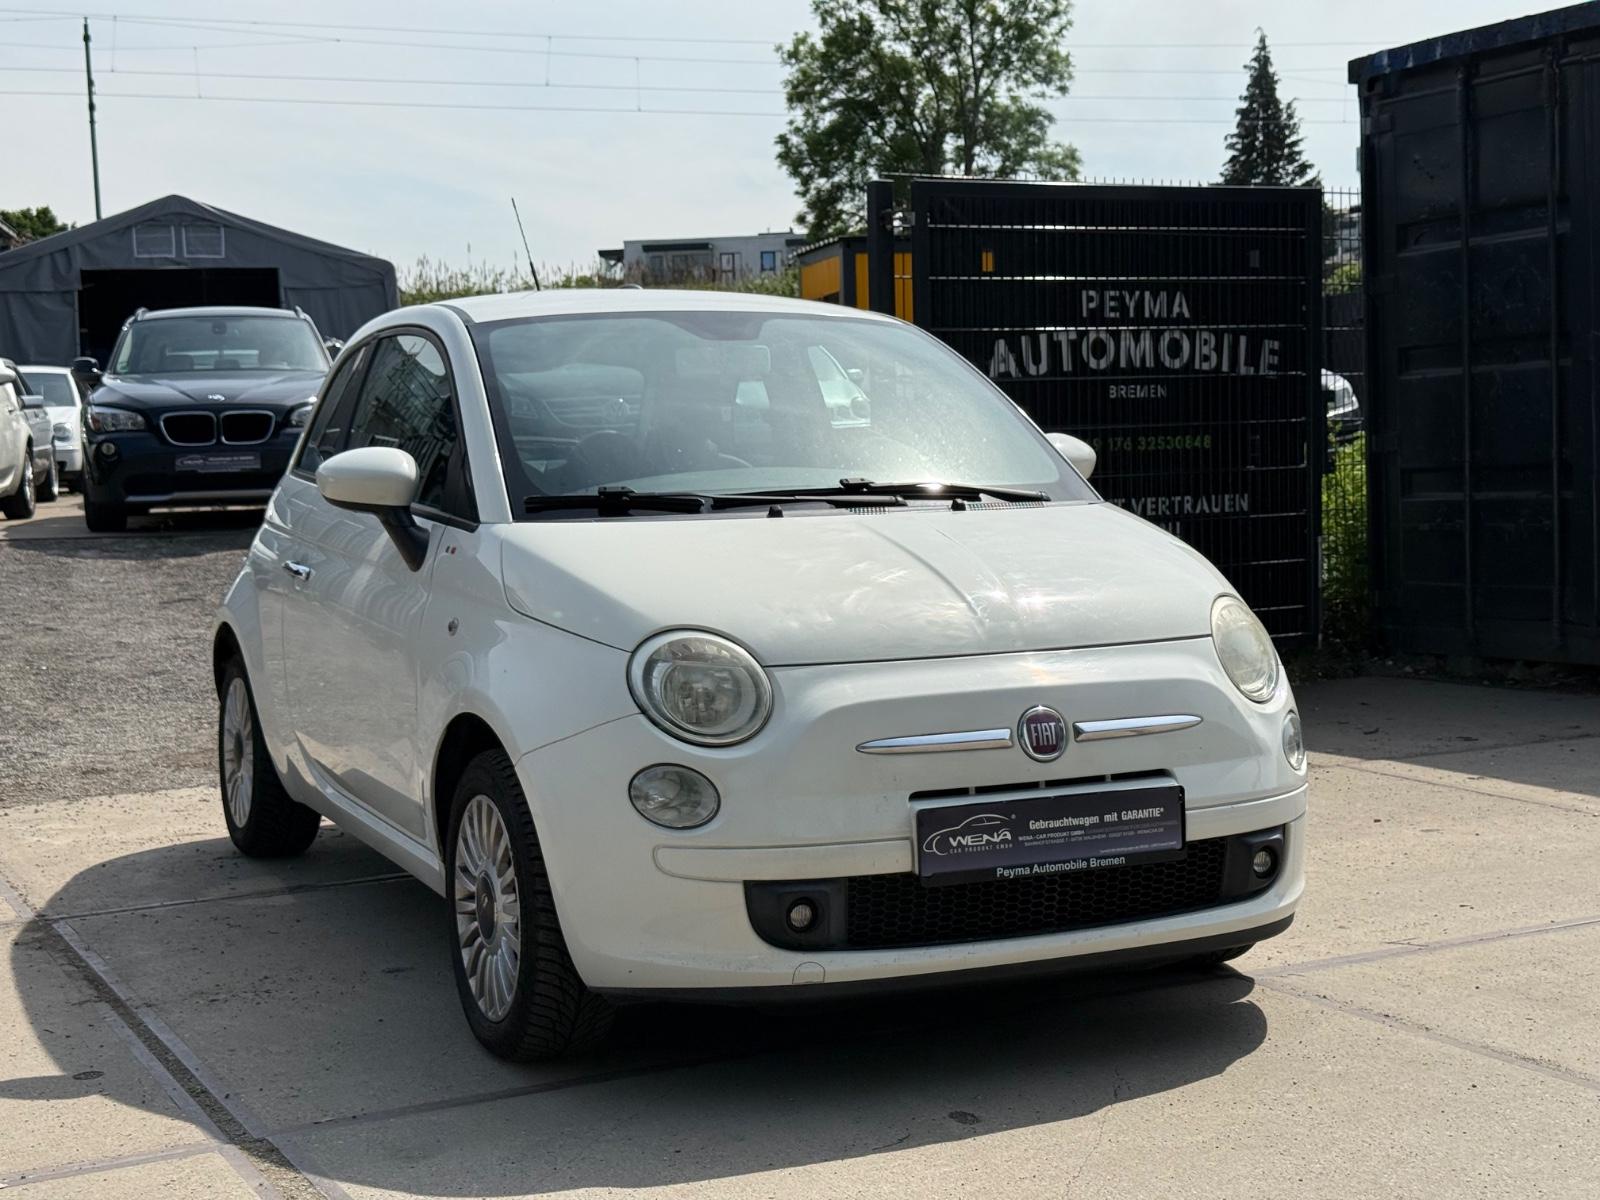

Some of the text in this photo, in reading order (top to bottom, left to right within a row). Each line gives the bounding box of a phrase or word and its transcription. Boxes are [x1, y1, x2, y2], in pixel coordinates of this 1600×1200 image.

[1081, 289, 1191, 319] PEYMA
[989, 330, 1282, 378] AUTOMOBILE
[1109, 384, 1167, 399] BREMEN
[1108, 436, 1132, 451] 176
[1131, 493, 1249, 516] VERTRAUEN
[1030, 722, 1057, 746] FIAT
[1029, 815, 1099, 830] Gebrauchtwagen
[1104, 811, 1119, 823] mit
[949, 829, 1012, 847] WENA
[997, 855, 1126, 878] Peyma Automobile Bremen
